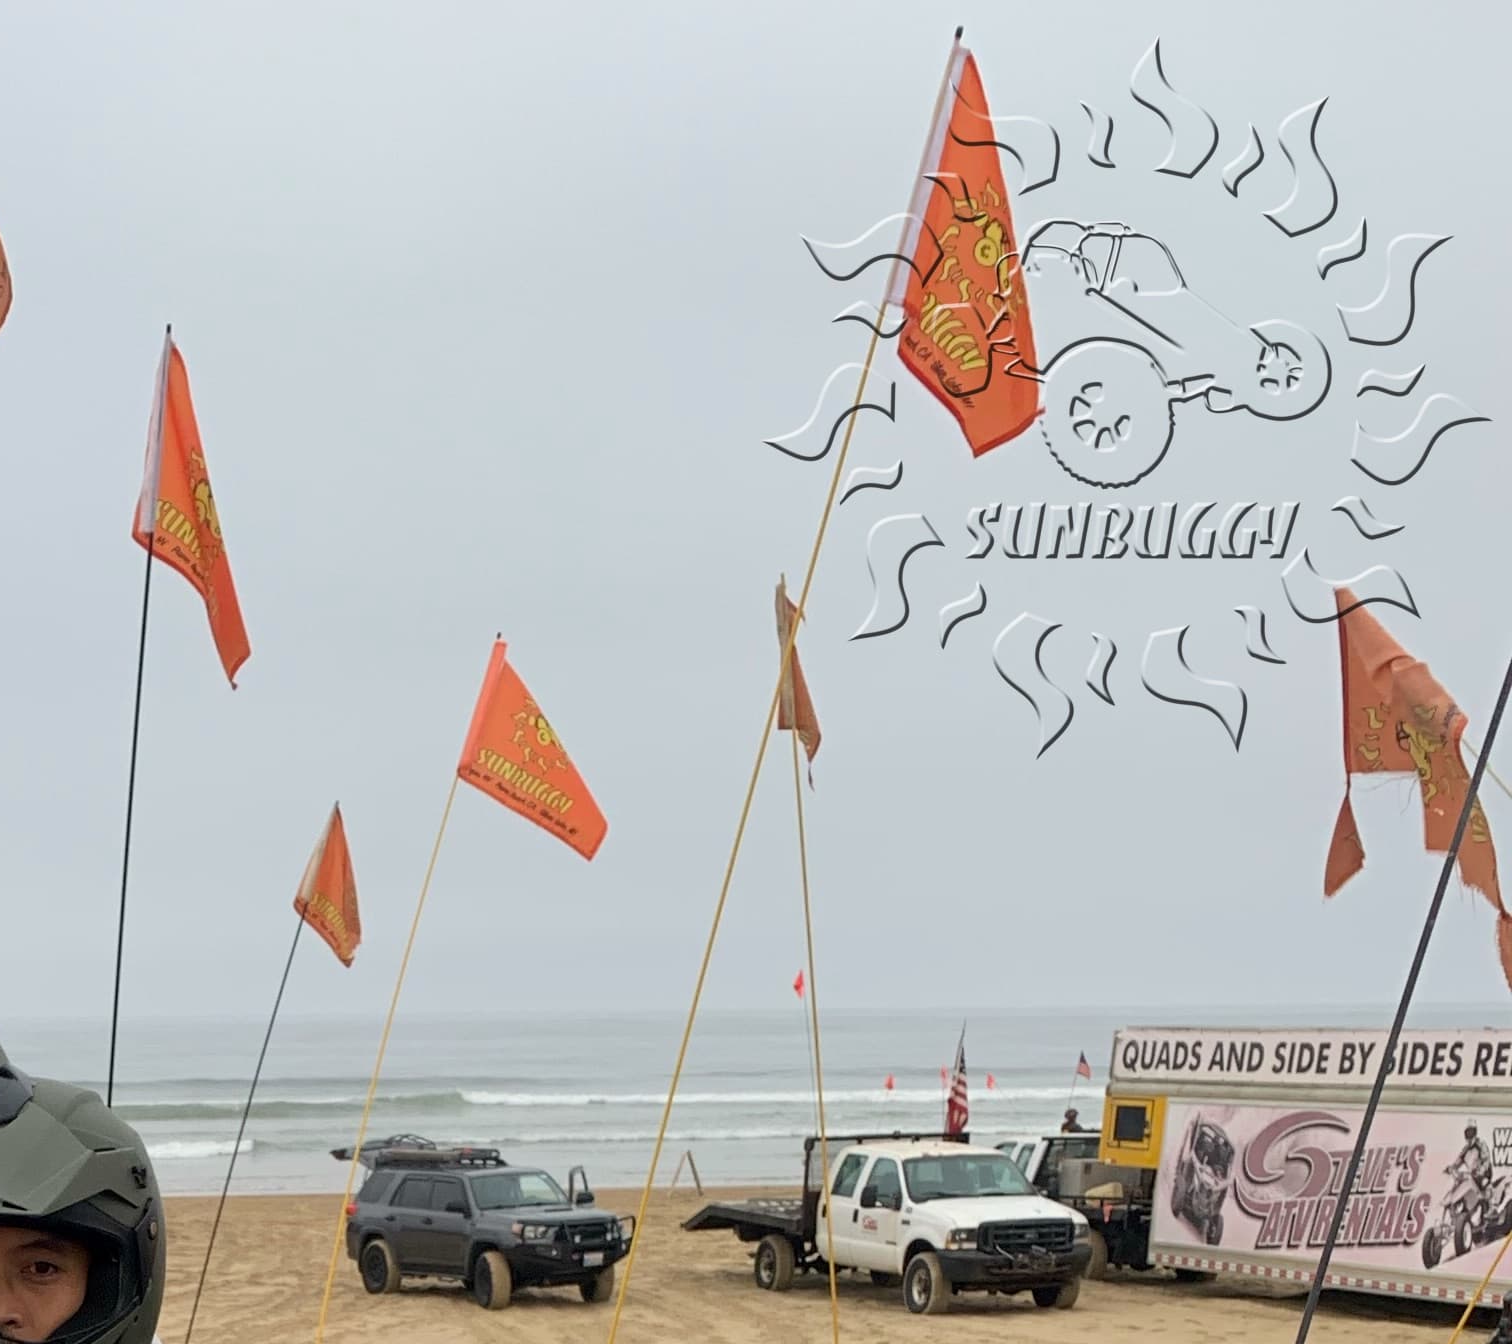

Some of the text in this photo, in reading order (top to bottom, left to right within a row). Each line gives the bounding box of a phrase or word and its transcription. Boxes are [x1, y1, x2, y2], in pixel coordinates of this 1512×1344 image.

[476, 748, 575, 815] SUNBUGGY
[1122, 1040, 1203, 1073] QUADS
[1208, 1041, 1265, 1073] AND
[1272, 1041, 1331, 1075] SIDE
[1338, 1042, 1376, 1075] BY
[1472, 1042, 1512, 1078] RE
